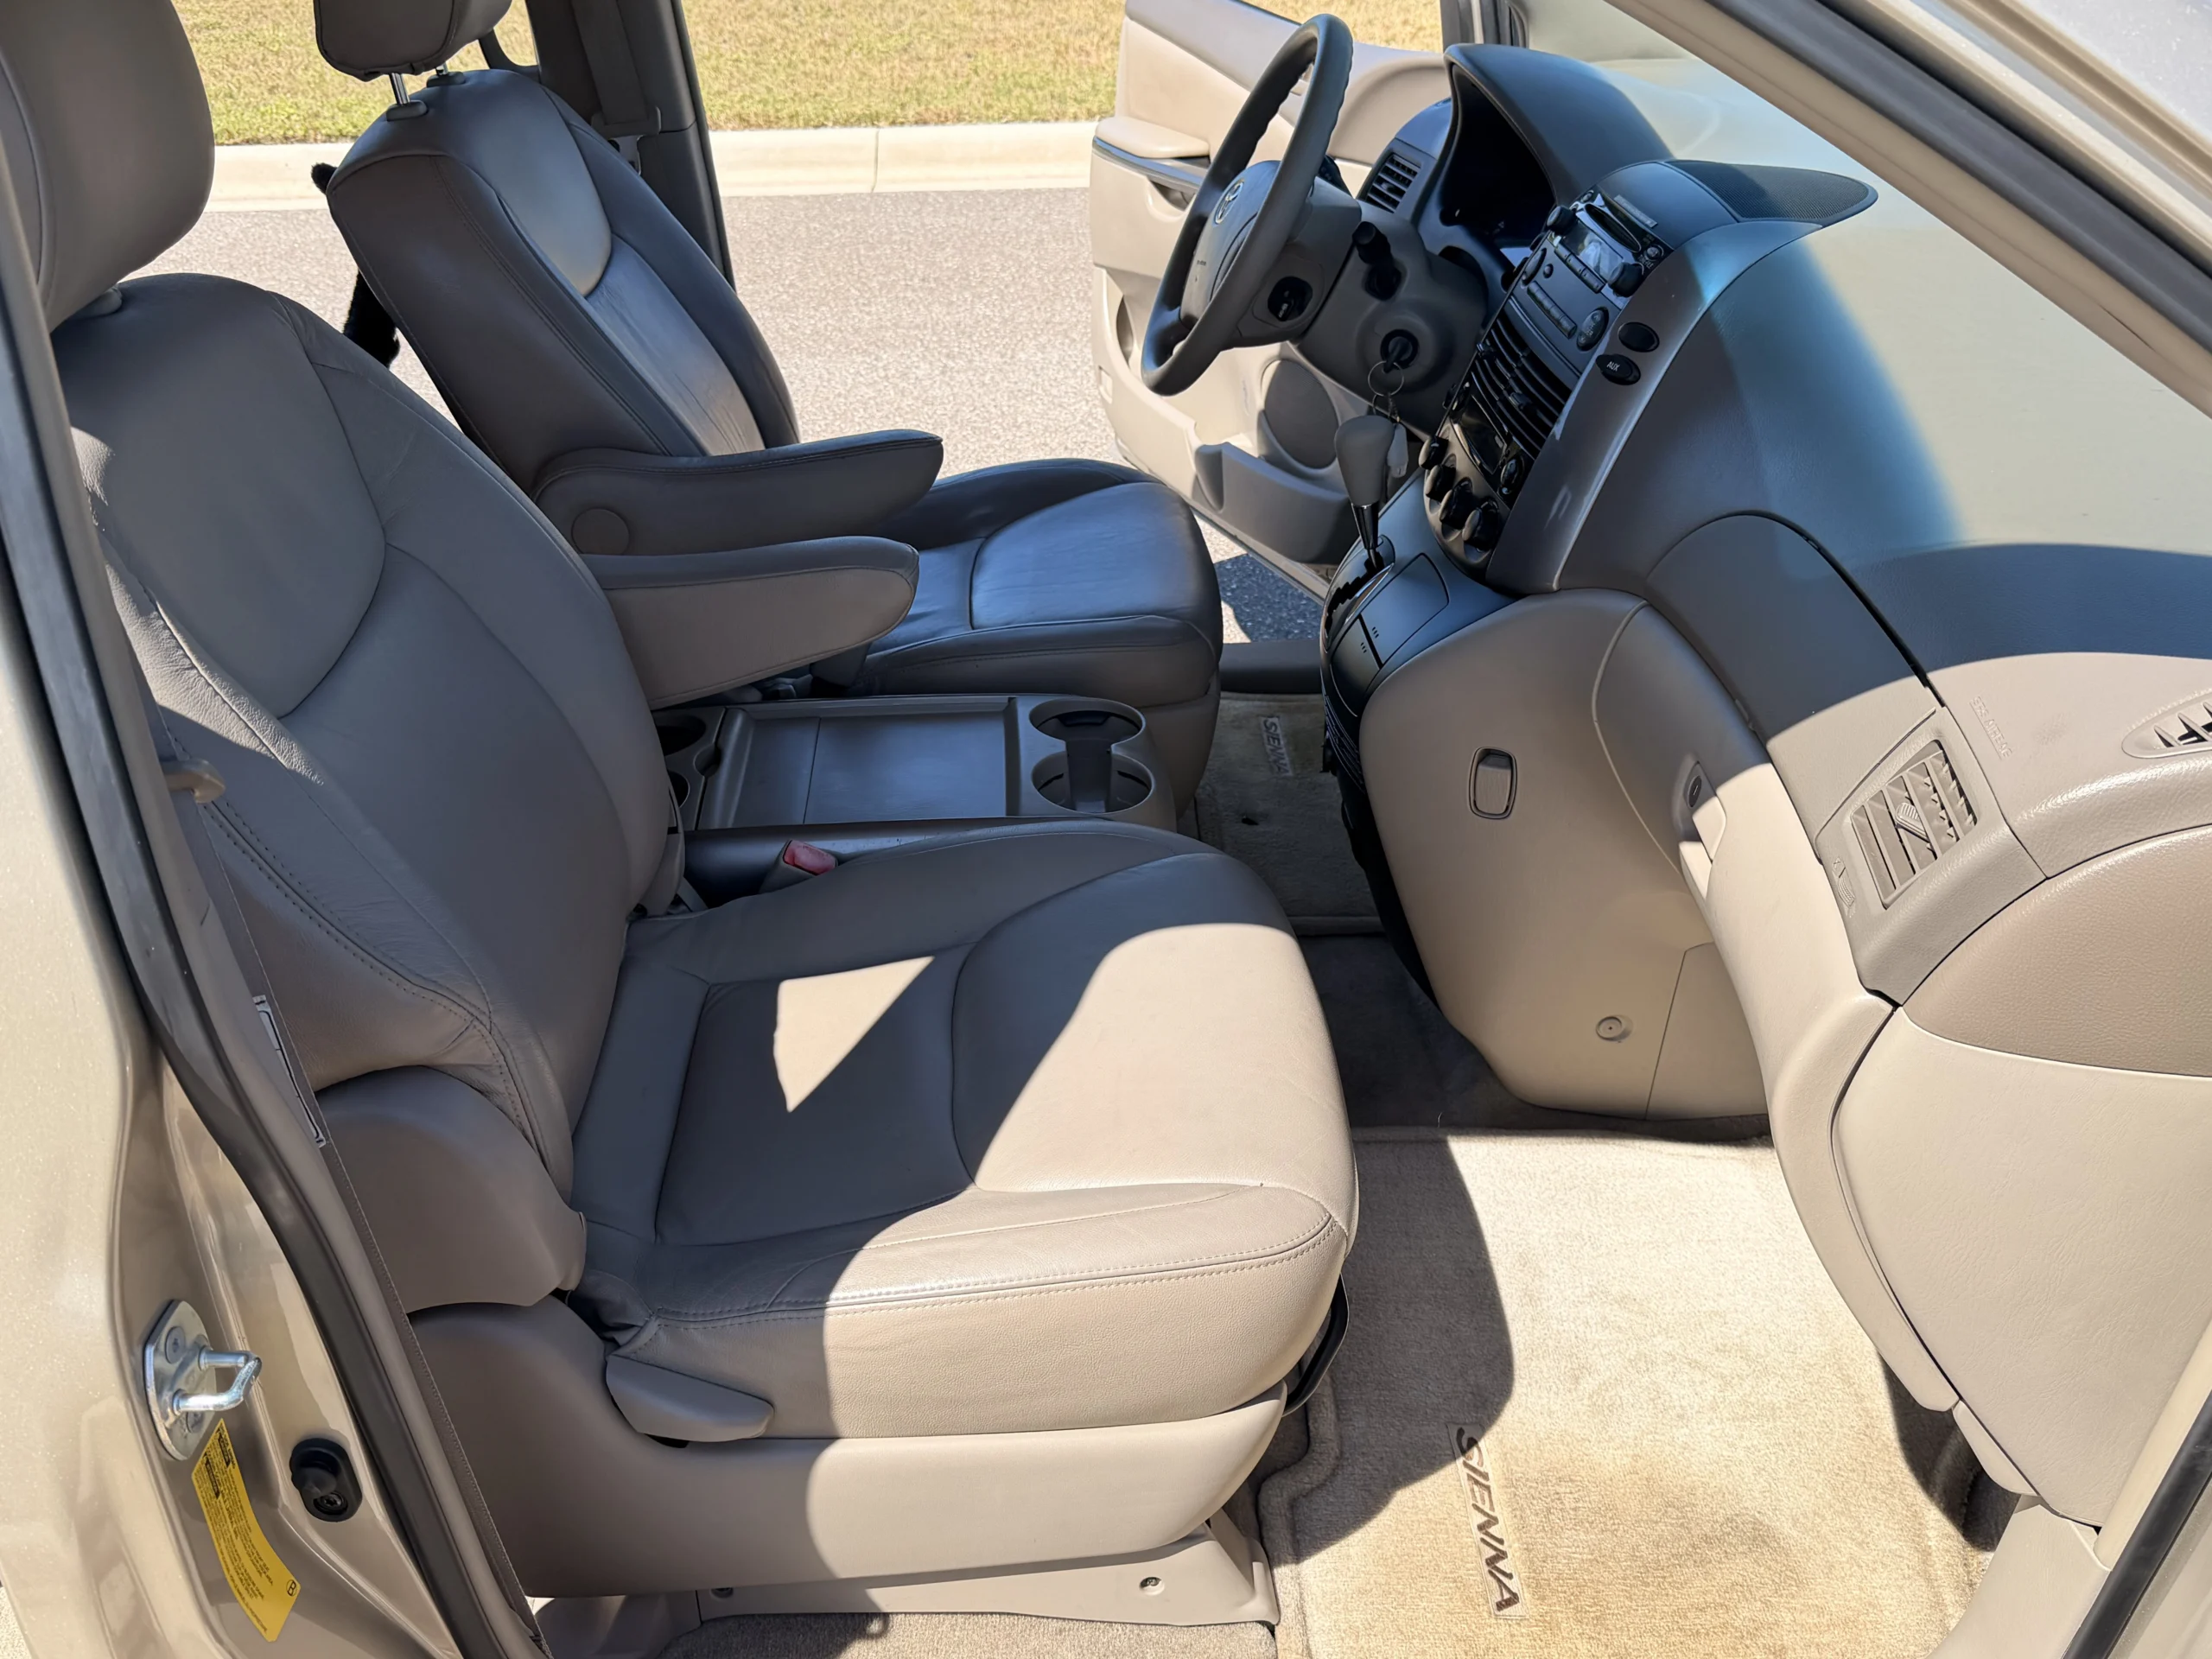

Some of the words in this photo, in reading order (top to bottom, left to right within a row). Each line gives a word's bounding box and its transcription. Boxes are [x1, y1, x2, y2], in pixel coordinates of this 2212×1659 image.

[1606, 360, 1620, 372] AUX
[1263, 718, 1290, 775] SIENNA
[1970, 696, 1990, 718] SRS
[1983, 719, 2012, 758] AIRBAG
[1456, 1427, 1520, 1611] SIENNA
